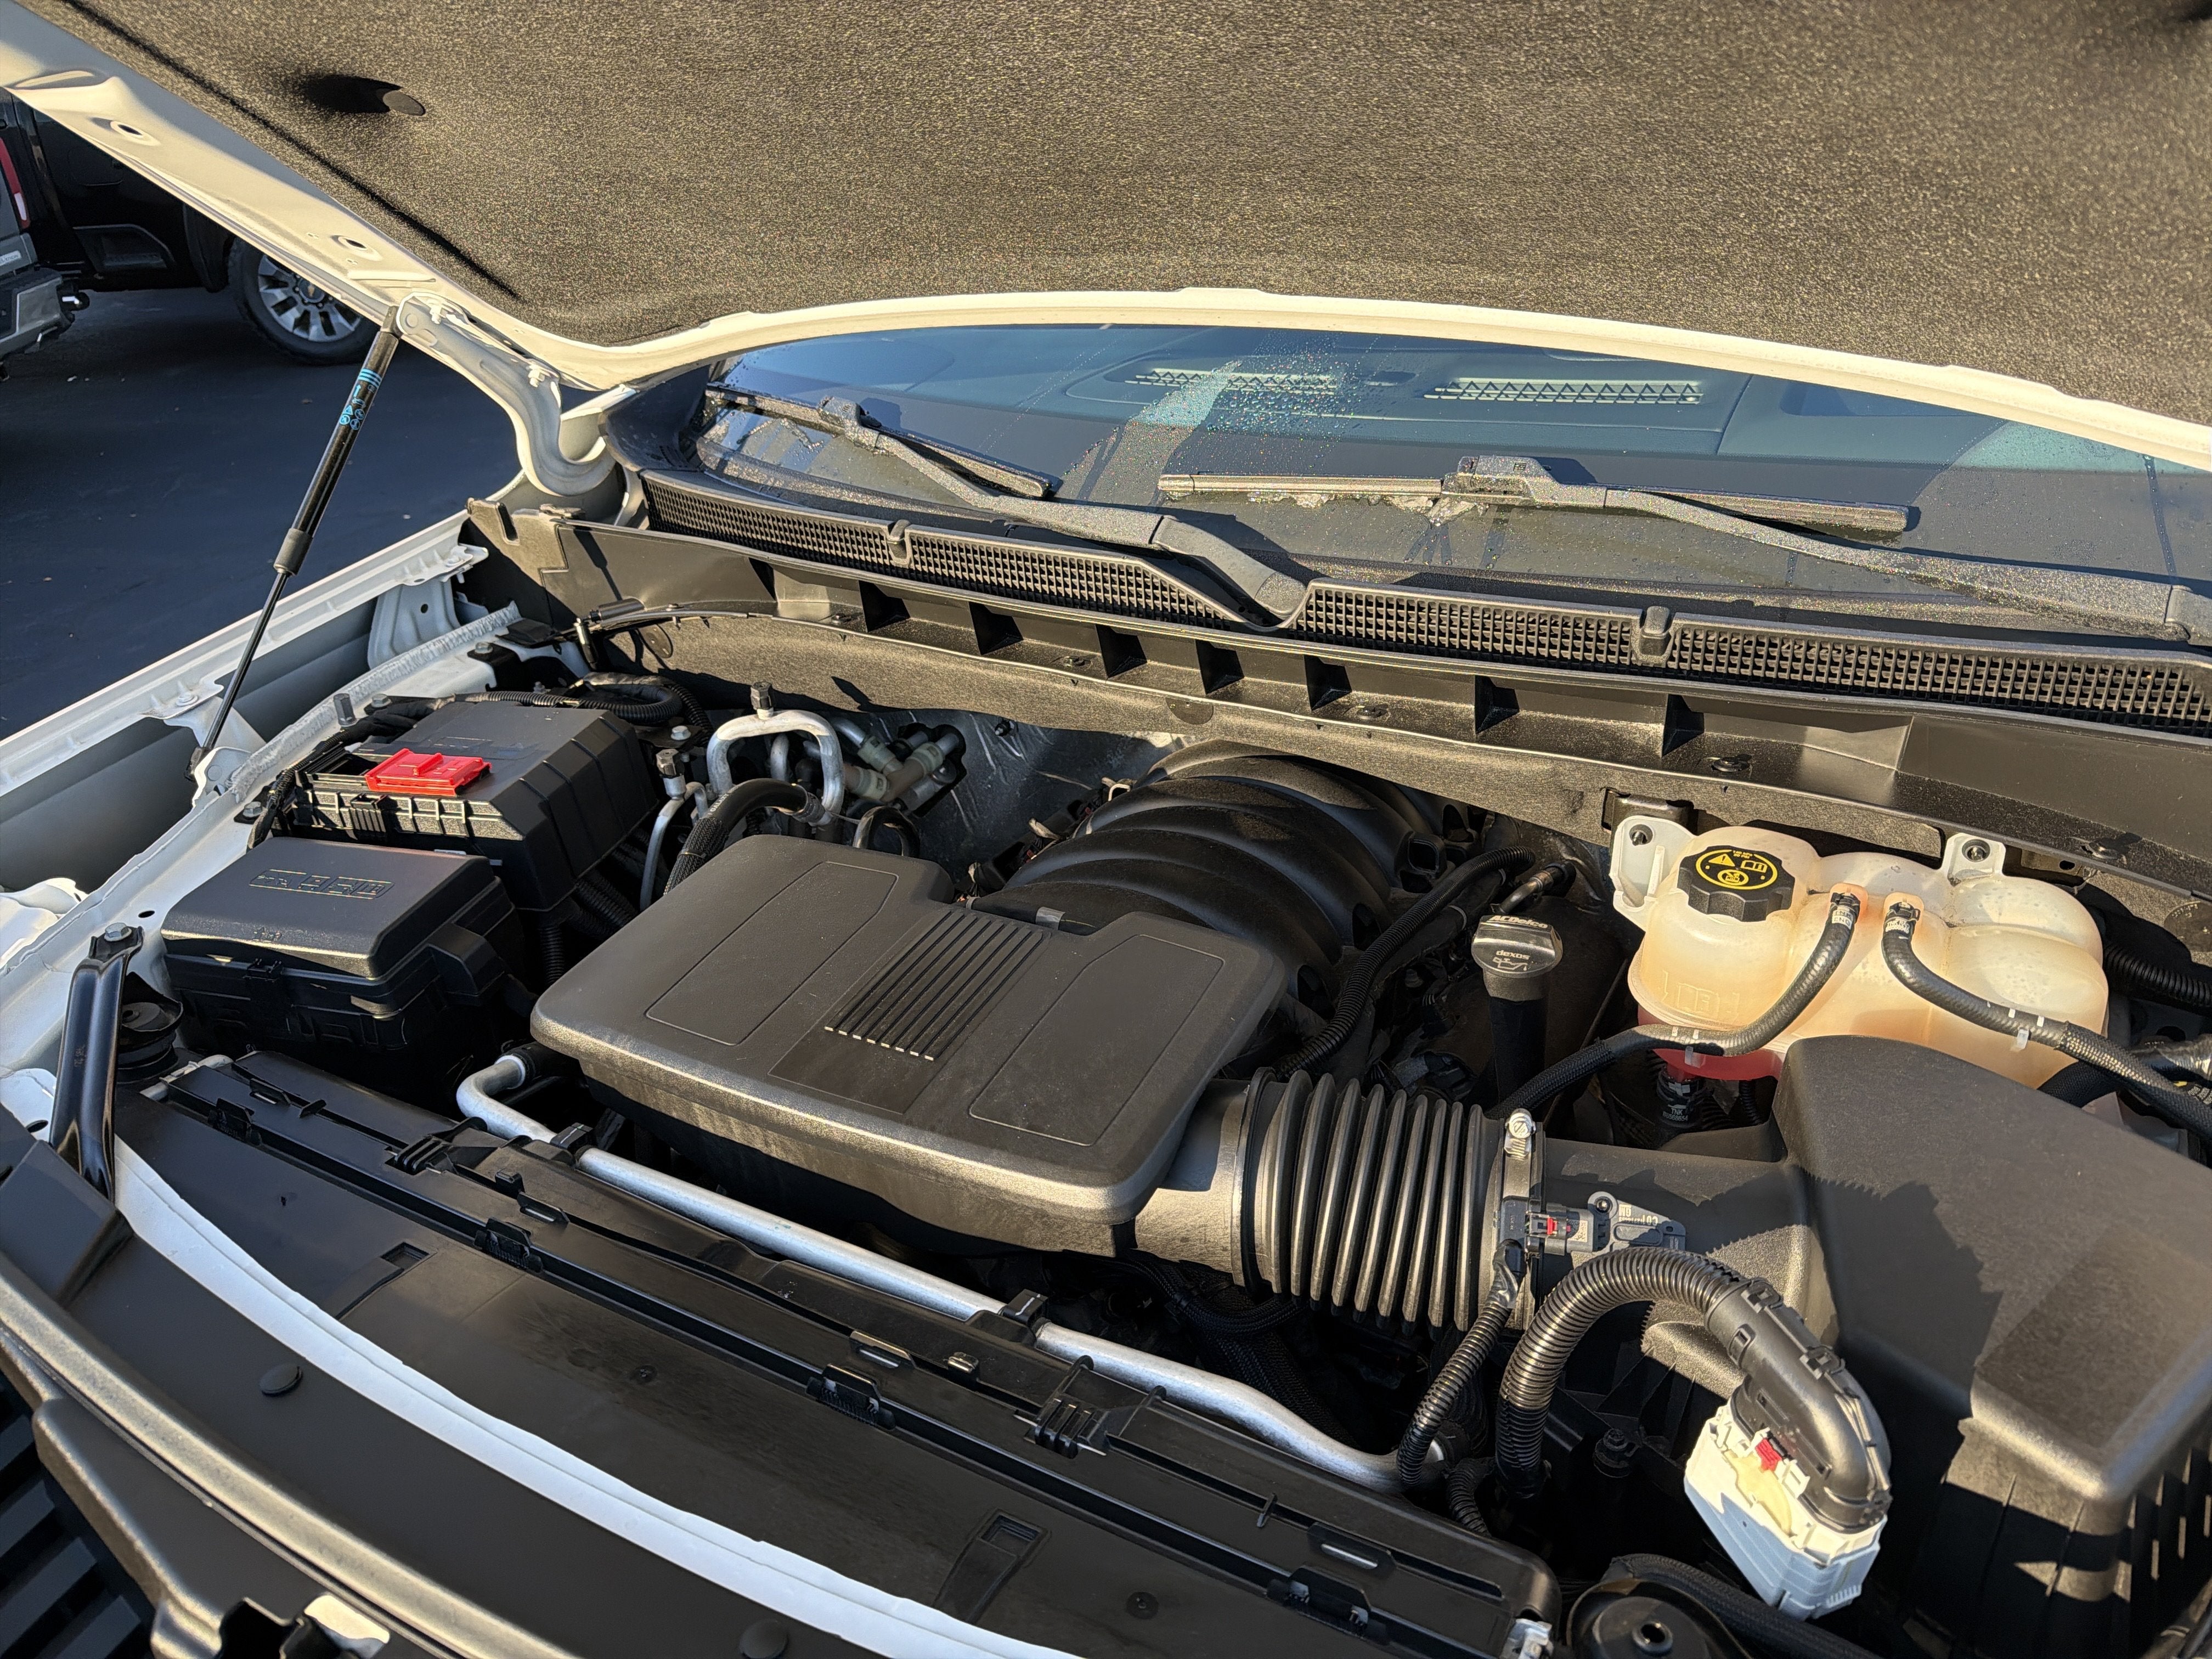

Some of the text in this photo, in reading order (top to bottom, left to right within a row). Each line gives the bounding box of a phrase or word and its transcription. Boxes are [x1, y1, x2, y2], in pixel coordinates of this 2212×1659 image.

[1489, 915, 1548, 928] ACDelco
[1496, 950, 1530, 960] dexos
[1618, 1206, 1632, 1217] GM
